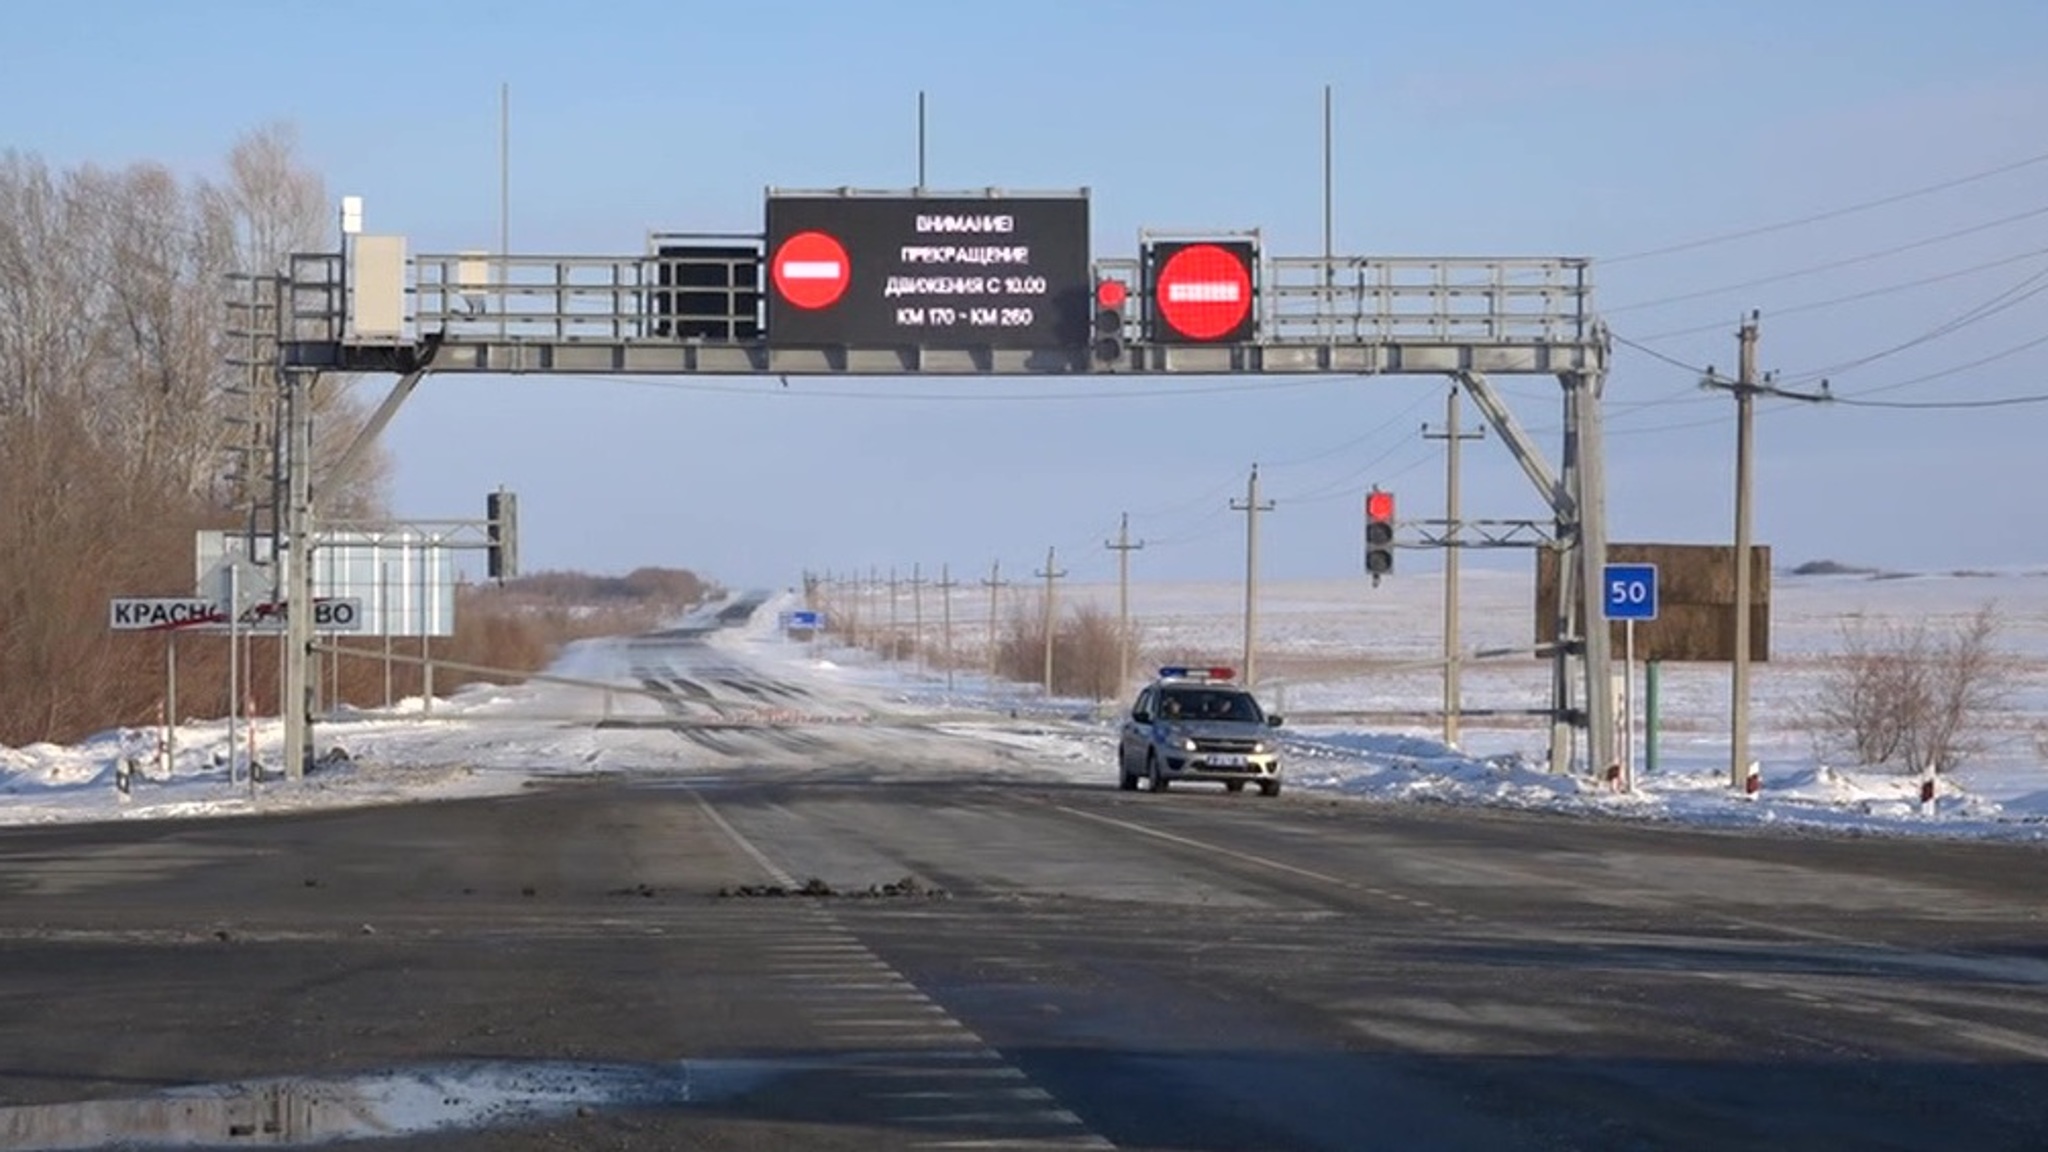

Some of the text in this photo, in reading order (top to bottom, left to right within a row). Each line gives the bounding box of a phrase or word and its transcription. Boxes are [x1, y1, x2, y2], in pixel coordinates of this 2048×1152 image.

[901, 246, 1029, 264] ПРЕКРАЩЕНИЕ
[884, 277, 1047, 297] ДВИЖЕНИЯ С 10.00
[896, 308, 924, 325] КМ
[928, 308, 955, 325] 170
[970, 308, 998, 325] КМ
[1001, 308, 1033, 326] 260
[1612, 581, 1647, 604] 50
